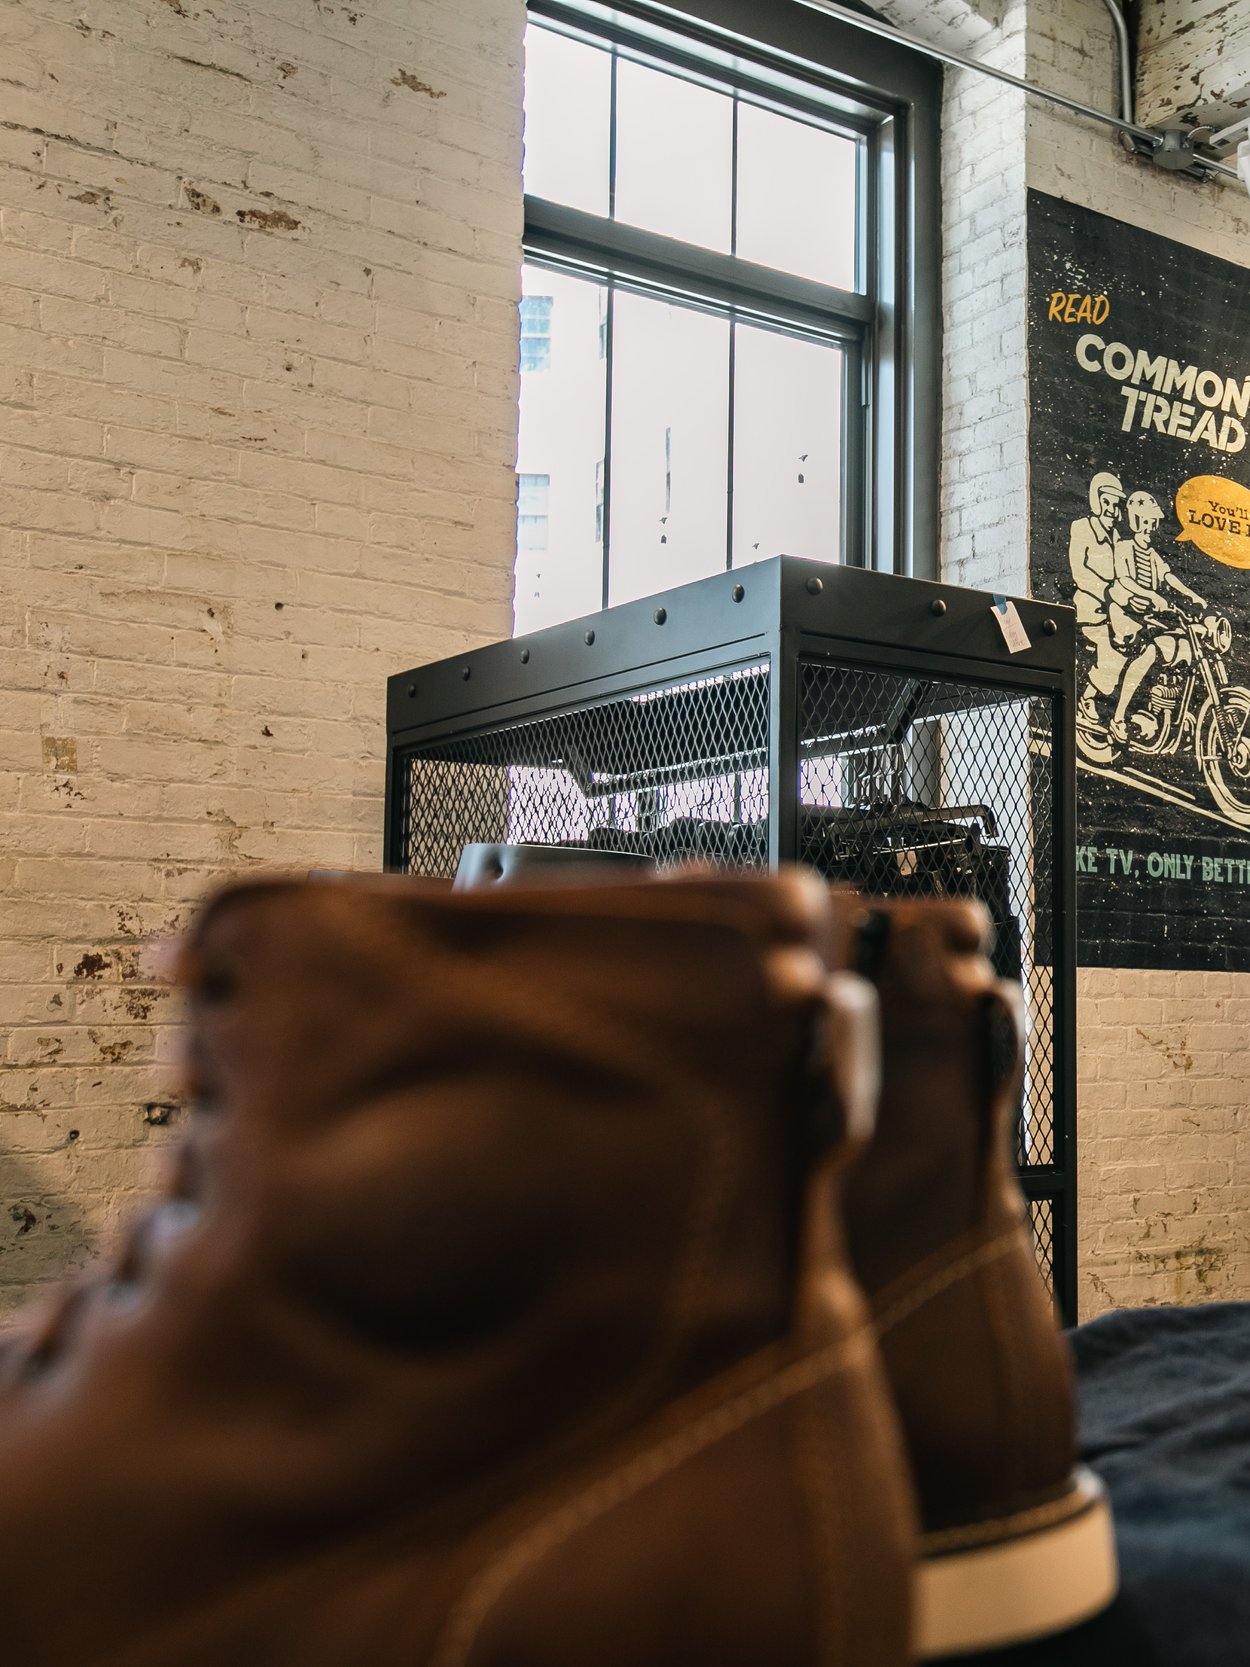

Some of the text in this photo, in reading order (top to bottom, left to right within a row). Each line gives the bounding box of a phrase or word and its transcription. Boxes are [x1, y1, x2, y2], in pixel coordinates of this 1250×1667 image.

[1048, 291, 1110, 325] READ
[1120, 385, 1246, 453] TREAD
[1188, 509, 1241, 535] LOVE
[1207, 500, 1249, 520] You'll
[1076, 846, 1098, 873] KE
[1105, 847, 1139, 878] TV,
[1147, 851, 1195, 880] ONLY
